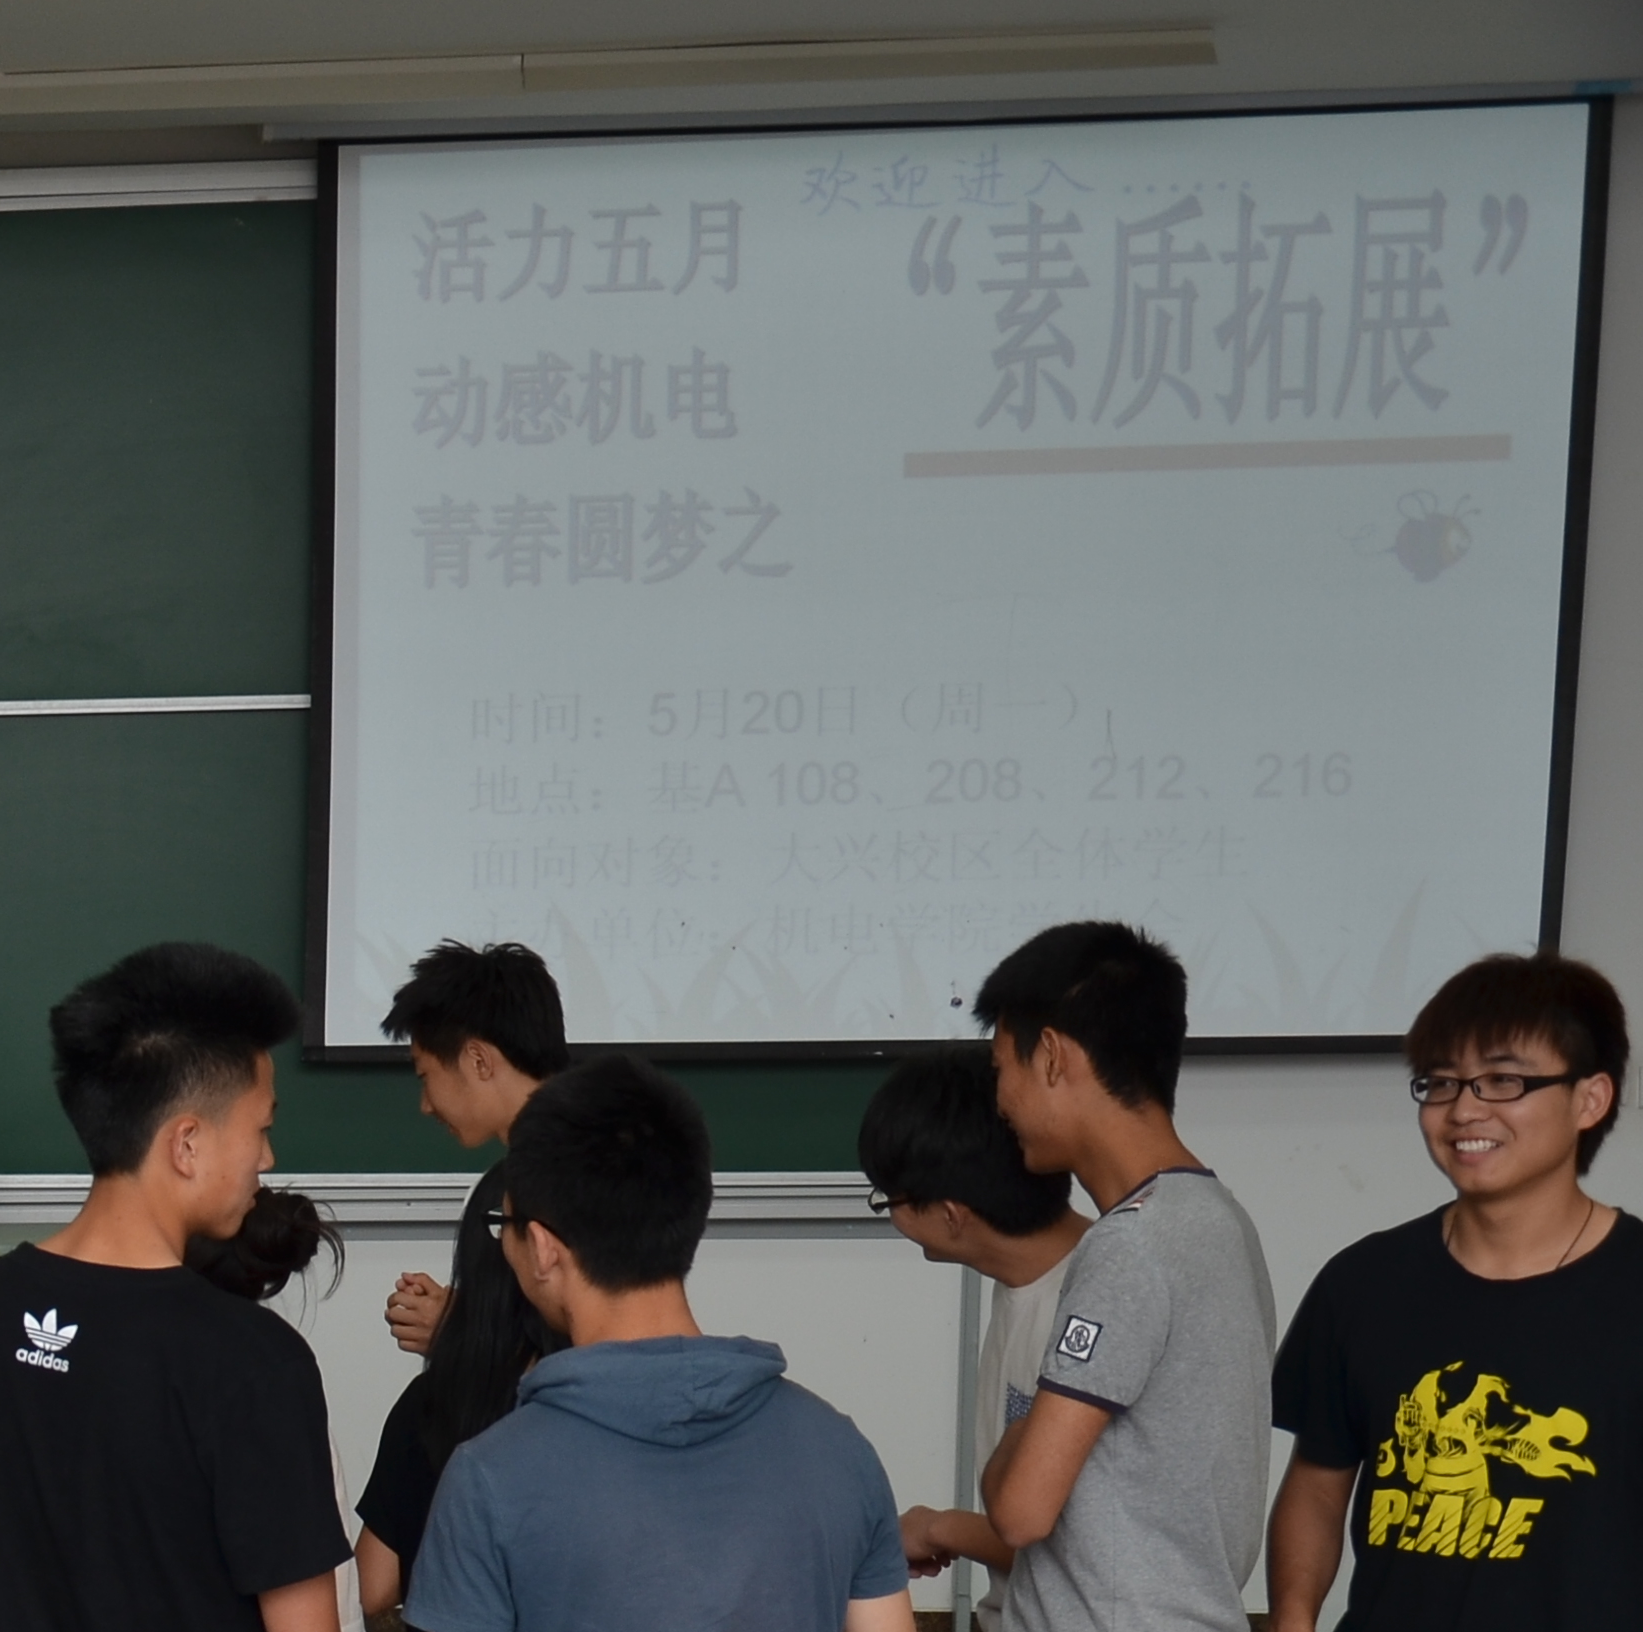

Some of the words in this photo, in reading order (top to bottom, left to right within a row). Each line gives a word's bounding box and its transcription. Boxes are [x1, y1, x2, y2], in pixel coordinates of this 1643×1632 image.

[411, 197, 746, 304] 活力五月
[411, 346, 738, 449] 动感机电
[411, 486, 794, 590] 青春圆梦之
[16, 1348, 69, 1373] adidas
[1368, 1489, 1544, 1558] PEACE
